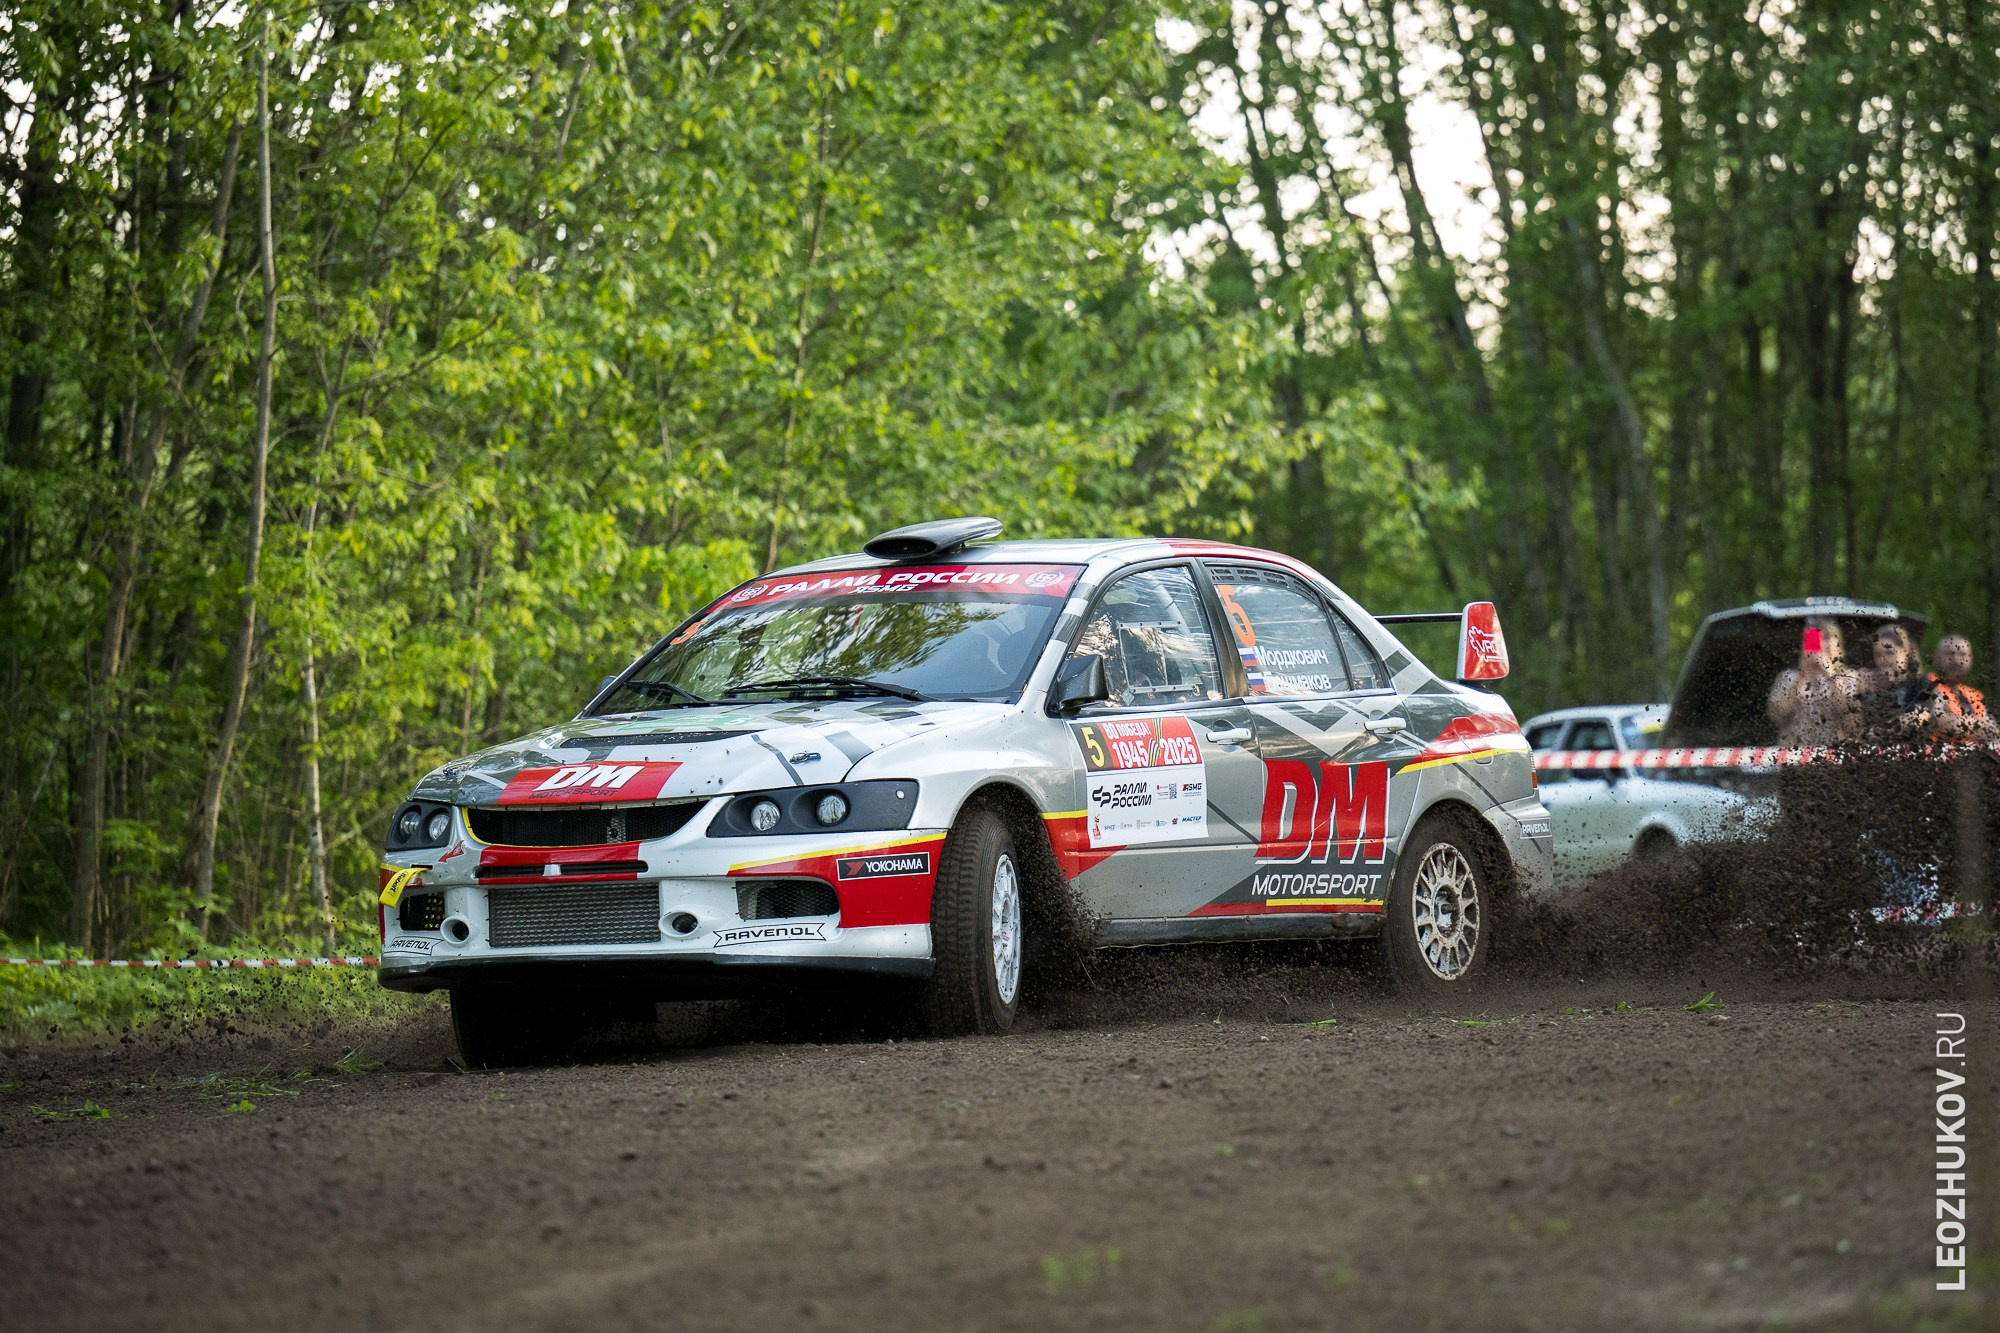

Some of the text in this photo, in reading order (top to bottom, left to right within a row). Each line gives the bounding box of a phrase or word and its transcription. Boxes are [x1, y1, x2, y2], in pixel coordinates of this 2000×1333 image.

[767, 572, 1020, 596] РАЛЛИ РОССИИ
[1217, 584, 1256, 647] 5
[1254, 646, 1330, 671] Мордкович
[1102, 722, 1151, 740] 80 ПОБЕДА!
[1081, 727, 1105, 768] 5
[1112, 736, 1198, 769] 1945 2025
[532, 764, 645, 792] DM
[528, 787, 619, 800] MOTORSPORT
[1113, 782, 1148, 795] РАЛЛИ
[1111, 794, 1152, 809] РОССИИ
[1252, 760, 1390, 865] DM
[1522, 823, 1549, 834] RAVENOL
[866, 858, 923, 873] YOKOHAMA
[1251, 874, 1382, 896] MOTORSPORT
[390, 939, 431, 950] RAVENOL
[724, 928, 815, 941] RAVENOL
